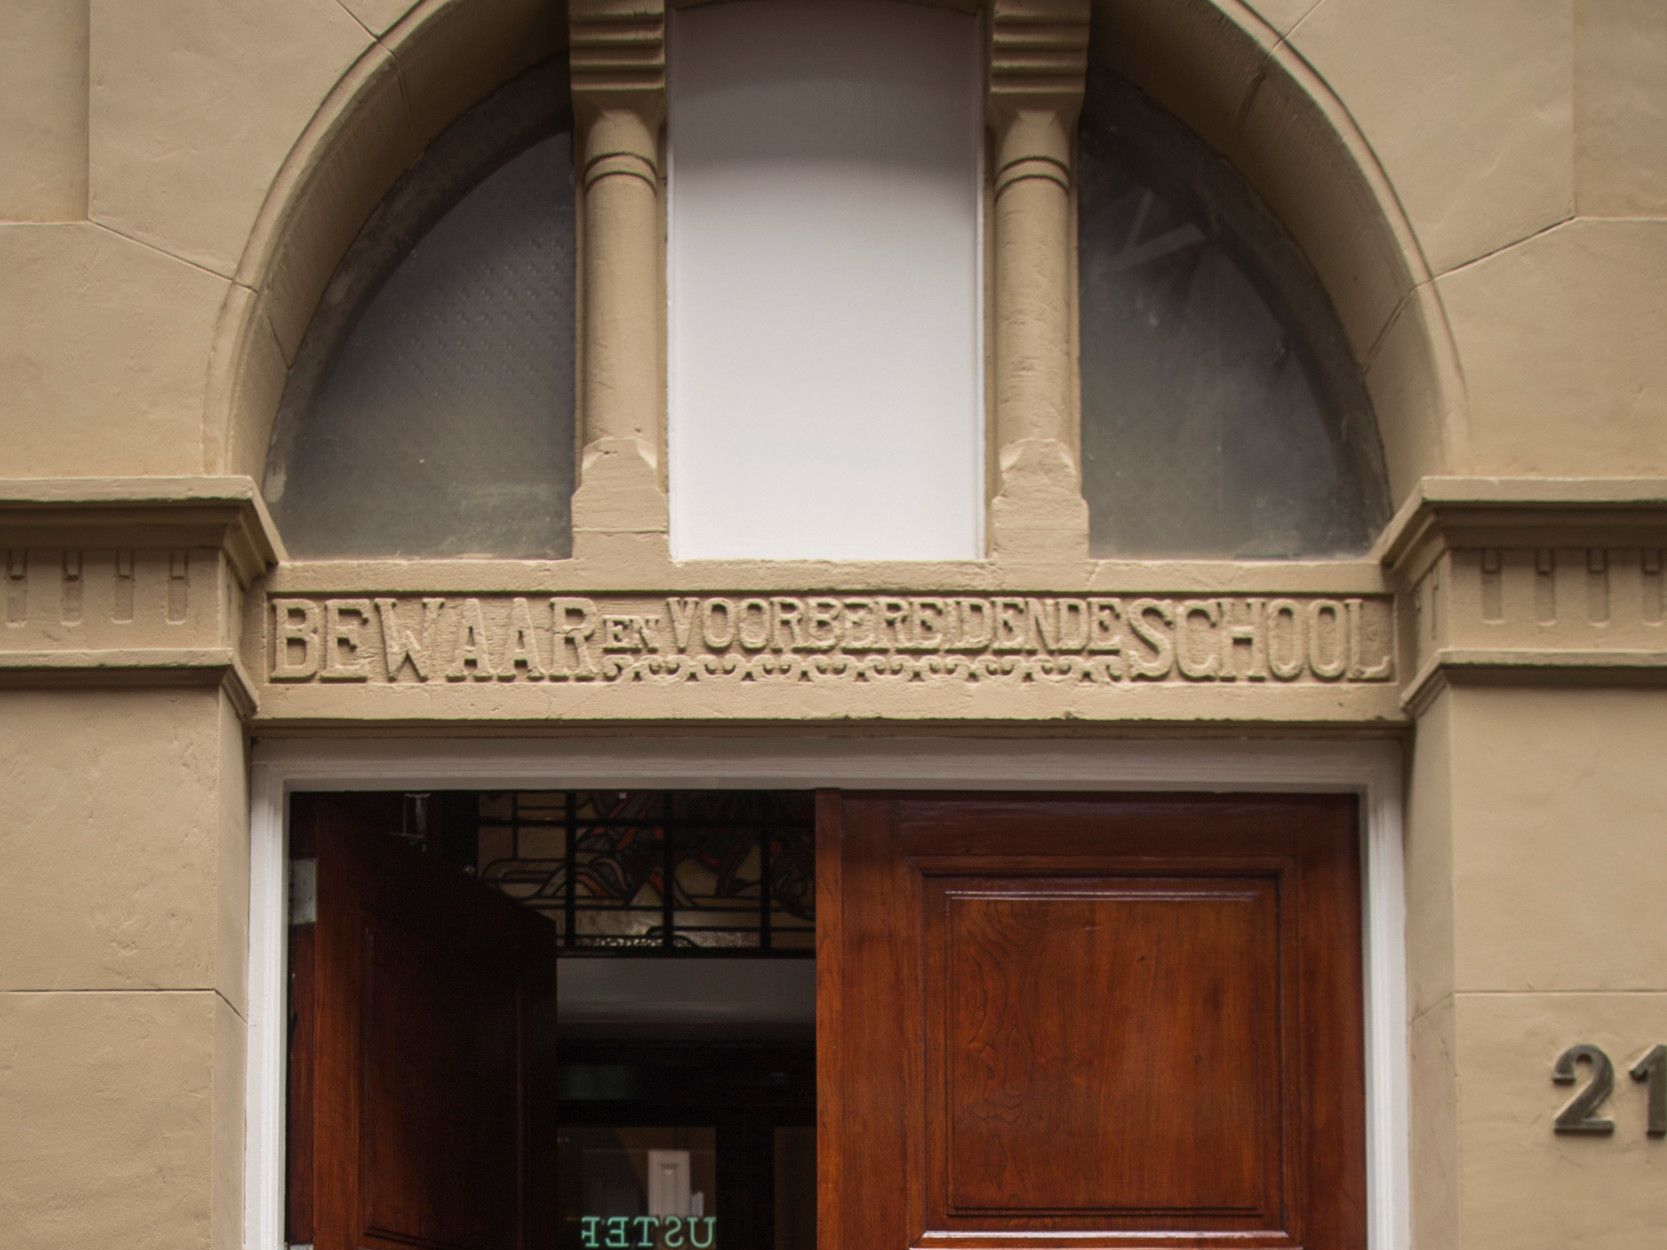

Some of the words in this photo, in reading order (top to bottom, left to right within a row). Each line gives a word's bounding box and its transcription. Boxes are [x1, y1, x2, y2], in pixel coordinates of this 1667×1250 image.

[270, 598, 597, 682] BEWAAR
[602, 614, 661, 653] EN
[1127, 598, 1393, 683] SCHOOL
[1552, 1043, 1667, 1138] 21
